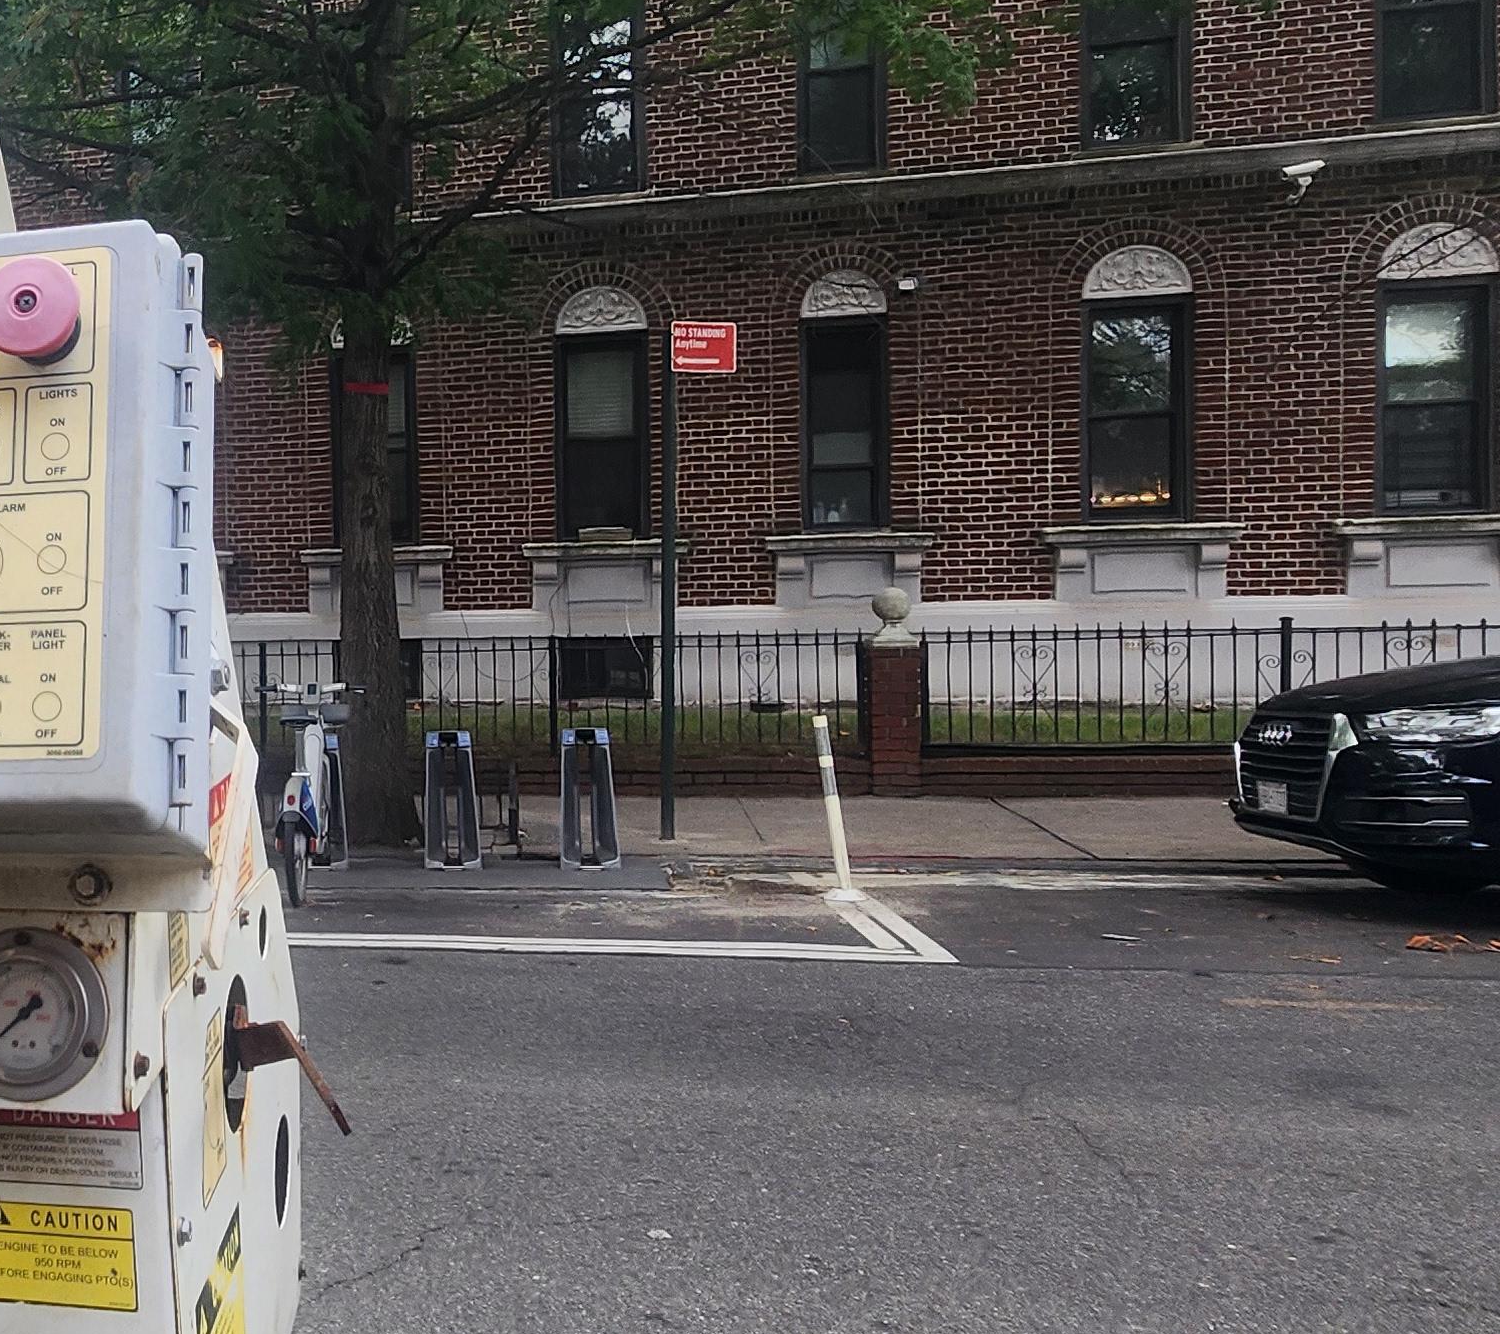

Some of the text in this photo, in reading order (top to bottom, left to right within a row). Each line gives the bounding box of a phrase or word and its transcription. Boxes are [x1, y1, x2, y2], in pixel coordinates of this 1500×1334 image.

[674, 327, 726, 338] NO STANDING
[675, 339, 708, 350] Anytime
[39, 389, 78, 400] LIGHTS
[49, 418, 65, 427] ON
[45, 467, 67, 477] OFF
[46, 533, 62, 542] ON
[41, 586, 63, 596] OFF
[30, 629, 67, 639] PANEL
[32, 640, 66, 650] LIGHT
[40, 673, 57, 683] ON
[35, 729, 57, 739] OFF
[13, 1110, 117, 1126] DANGER
[30, 1210, 118, 1232] CAUTION
[42, 1244, 57, 1255] TO
[60, 1245, 75, 1256] BE
[77, 1247, 119, 1259] BELOW
[34, 1257, 82, 1269] 950 RPM
[32, 1269, 93, 1284] ENGAGING
[95, 1274, 134, 1289] PTO(S)
